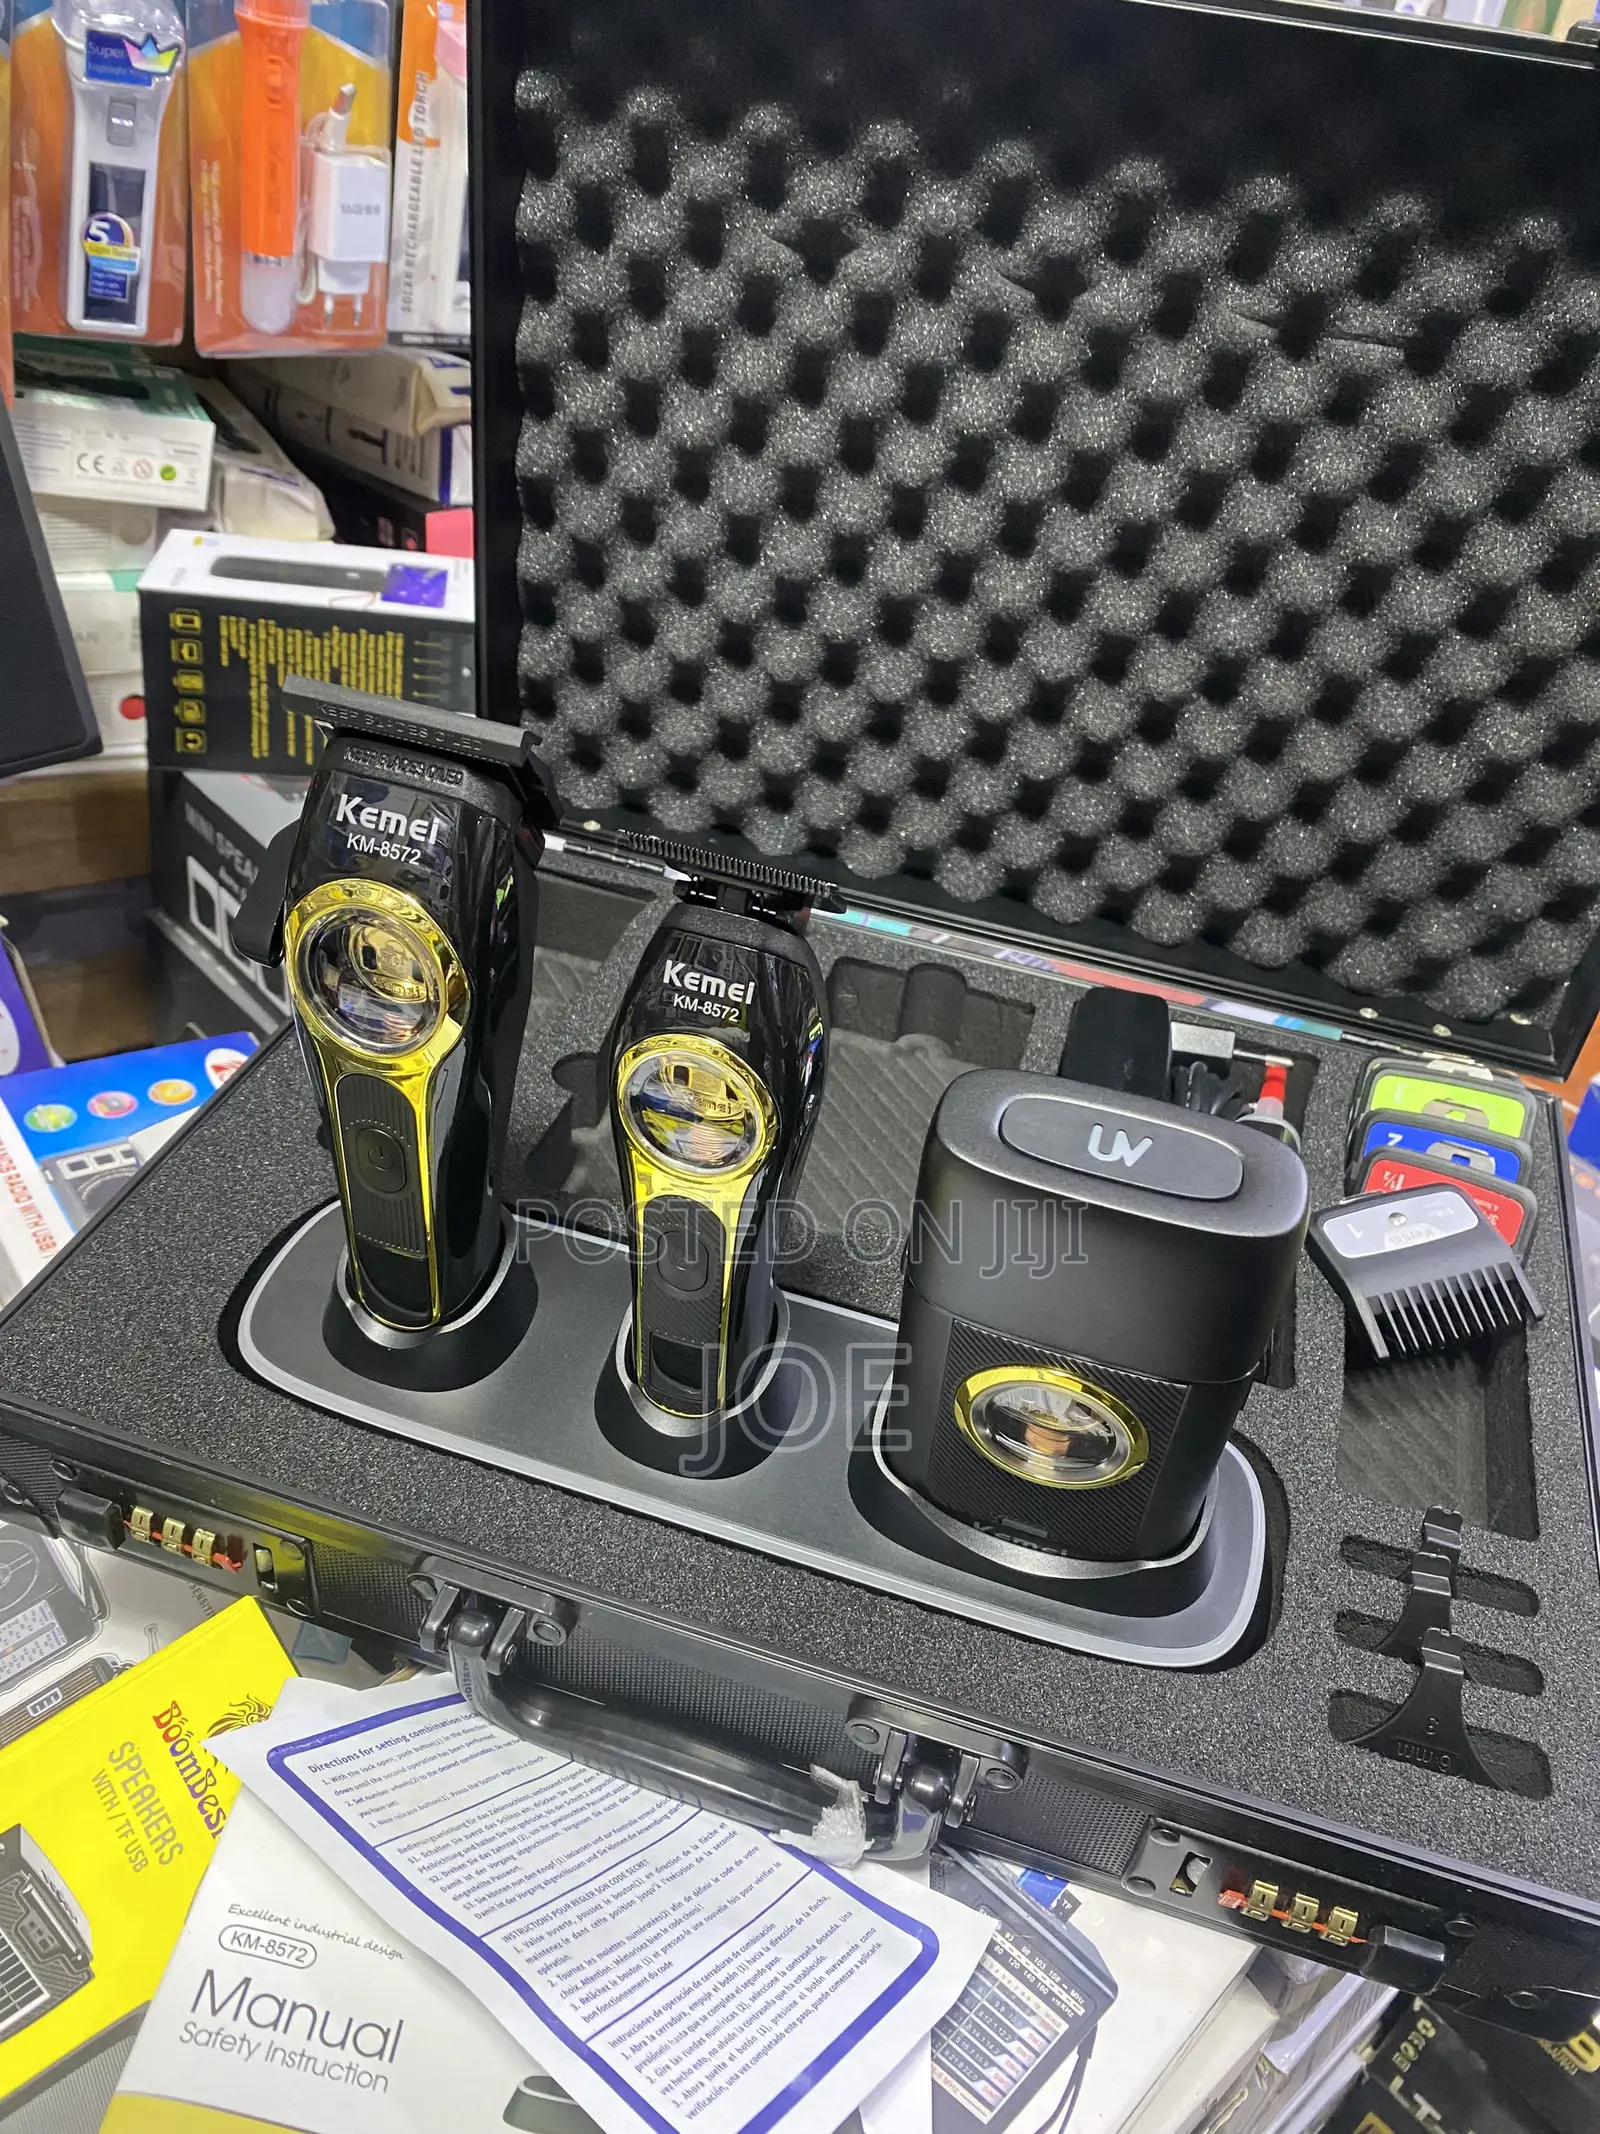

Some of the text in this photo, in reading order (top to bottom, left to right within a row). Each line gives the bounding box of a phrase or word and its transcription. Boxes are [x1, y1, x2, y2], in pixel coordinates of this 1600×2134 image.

[88, 41, 124, 58] Super
[86, 219, 111, 244] 5
[317, 703, 359, 720] KEEP
[365, 715, 428, 738] BLADES
[335, 793, 440, 845] Kemei
[346, 833, 422, 866] KM-8572
[663, 959, 756, 1005] Kemei
[673, 993, 740, 1023] KM-8572
[1086, 1122, 1154, 1168] UV
[5, 1173, 33, 1205] RADIO
[18, 1202, 49, 1231] WITH
[189, 1583, 216, 1617] SENSITI
[307, 1752, 360, 1773] Directions
[357, 1746, 374, 1757] for
[374, 1734, 410, 1750] setting
[408, 1717, 462, 1738] combination
[328, 1773, 348, 1783] With
[346, 1769, 360, 1777] the
[358, 1763, 376, 1772] lock
[376, 1757, 397, 1767] open,
[396, 1749, 414, 1760] push
[461, 1723, 488, 1734] direction
[91, 1769, 121, 1812] WITH
[108, 1740, 184, 1867] SPEAKERS
[115, 1816, 135, 1843] TF
[396, 1822, 469, 1854] Bedienungsanleitung
[464, 1817, 477, 1825] für
[476, 1812, 489, 1820] das
[123, 1841, 150, 1874] USB
[501, 1858, 649, 1942] INSTRUCTIONS POUR REGLER SON CODE SECRET
[1061, 1898, 1073, 1910] TF
[228, 1903, 405, 1961] Excellent industrial design
[229, 1931, 309, 1964] KM-8572
[579, 1965, 612, 1986] Attention
[612, 1941, 649, 1966] Mémorisez
[644, 1931, 663, 1944] bien
[667, 1917, 684, 1929] code
[580, 1960, 673, 2023] bon fonctionnement du code
[607, 1923, 776, 2048] Instrucciones de operación de cerraduras de combinación
[620, 2051, 632, 2060] 1.
[628, 2039, 648, 2055] Abra
[644, 2033, 656, 2042] la
[655, 2010, 691, 2036] cerradura,
[688, 1991, 713, 2011] empuje
[711, 1983, 721, 1993] el
[716, 1971, 739, 1987] botón
[735, 1962, 749, 1974] (1)
[744, 1950, 764, 1966] hacia
[769, 1924, 796, 1947] dirección
[794, 1916, 804, 1925] de
[807, 1895, 831, 1912] flecha,
[1034, 1956, 1047, 1970] 103
[1070, 1988, 1086, 2006] MHz
[190, 1968, 405, 2065] Manual
[681, 2080, 705, 2100] Ahora
[704, 2061, 728, 2081] suelte
[727, 2051, 738, 2062] el
[734, 2035, 758, 2055] botón
[770, 1999, 798, 2025] presione
[797, 1991, 807, 2000] el
[803, 1975, 826, 1993] botón
[824, 1943, 860, 1975] nuevamente
[859, 1927, 876, 1943] como
[179, 2020, 389, 2094] Safety Instruction
[685, 2085, 729, 2119] verificación,
[724, 2072, 740, 2086] una
[736, 2062, 752, 2075] vez
[749, 2032, 786, 2065] completado
[783, 2020, 798, 2034] este
[795, 2008, 815, 2024] paso,
[810, 1990, 831, 2011] puede
[828, 1967, 855, 1992] comenzar
